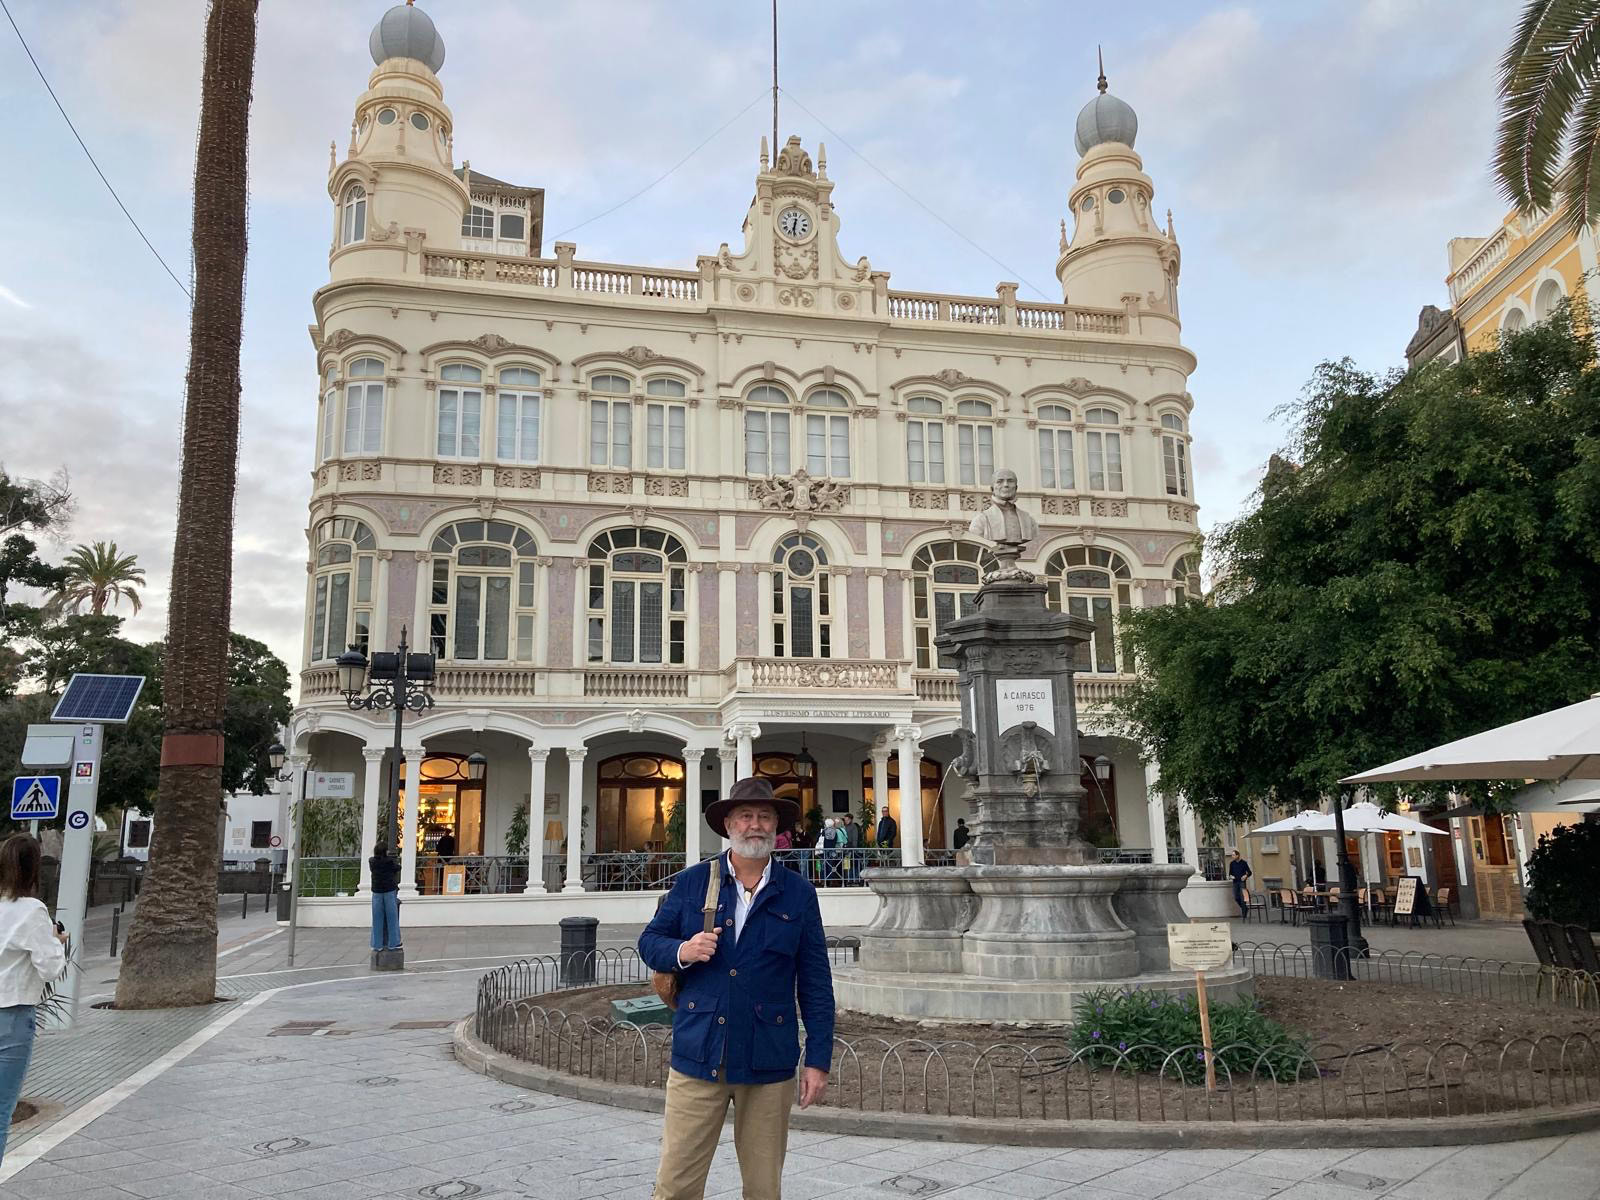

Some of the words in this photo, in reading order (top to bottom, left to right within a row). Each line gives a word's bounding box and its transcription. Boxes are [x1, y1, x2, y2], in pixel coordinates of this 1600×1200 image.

[1004, 692, 1008, 700] A
[1010, 692, 1046, 700] CAIRASCO
[1016, 704, 1035, 712] 1876
